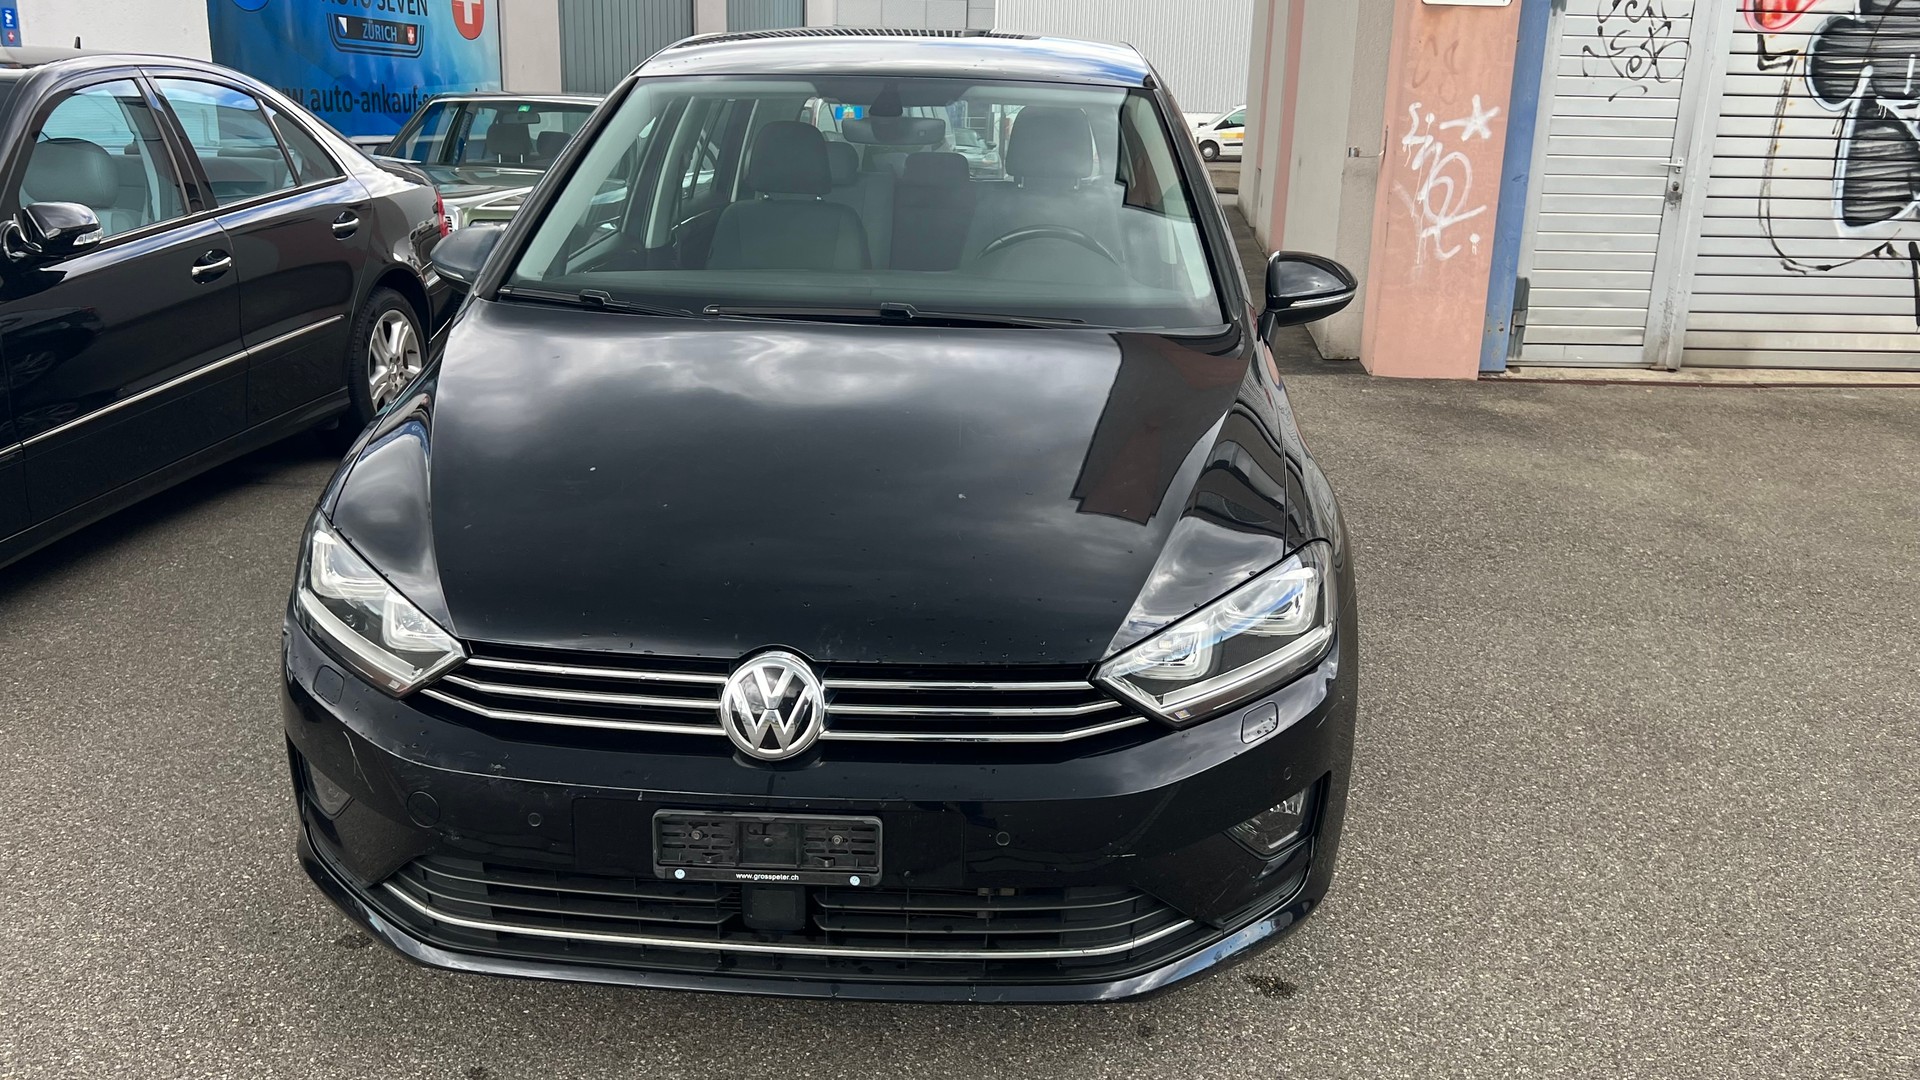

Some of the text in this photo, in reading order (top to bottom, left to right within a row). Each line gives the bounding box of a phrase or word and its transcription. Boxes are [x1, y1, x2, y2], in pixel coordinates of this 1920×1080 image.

[362, 20, 397, 42] ZÜRICH
[723, 656, 821, 757] VW
[735, 873, 799, 881] www.grosspeter.ch
